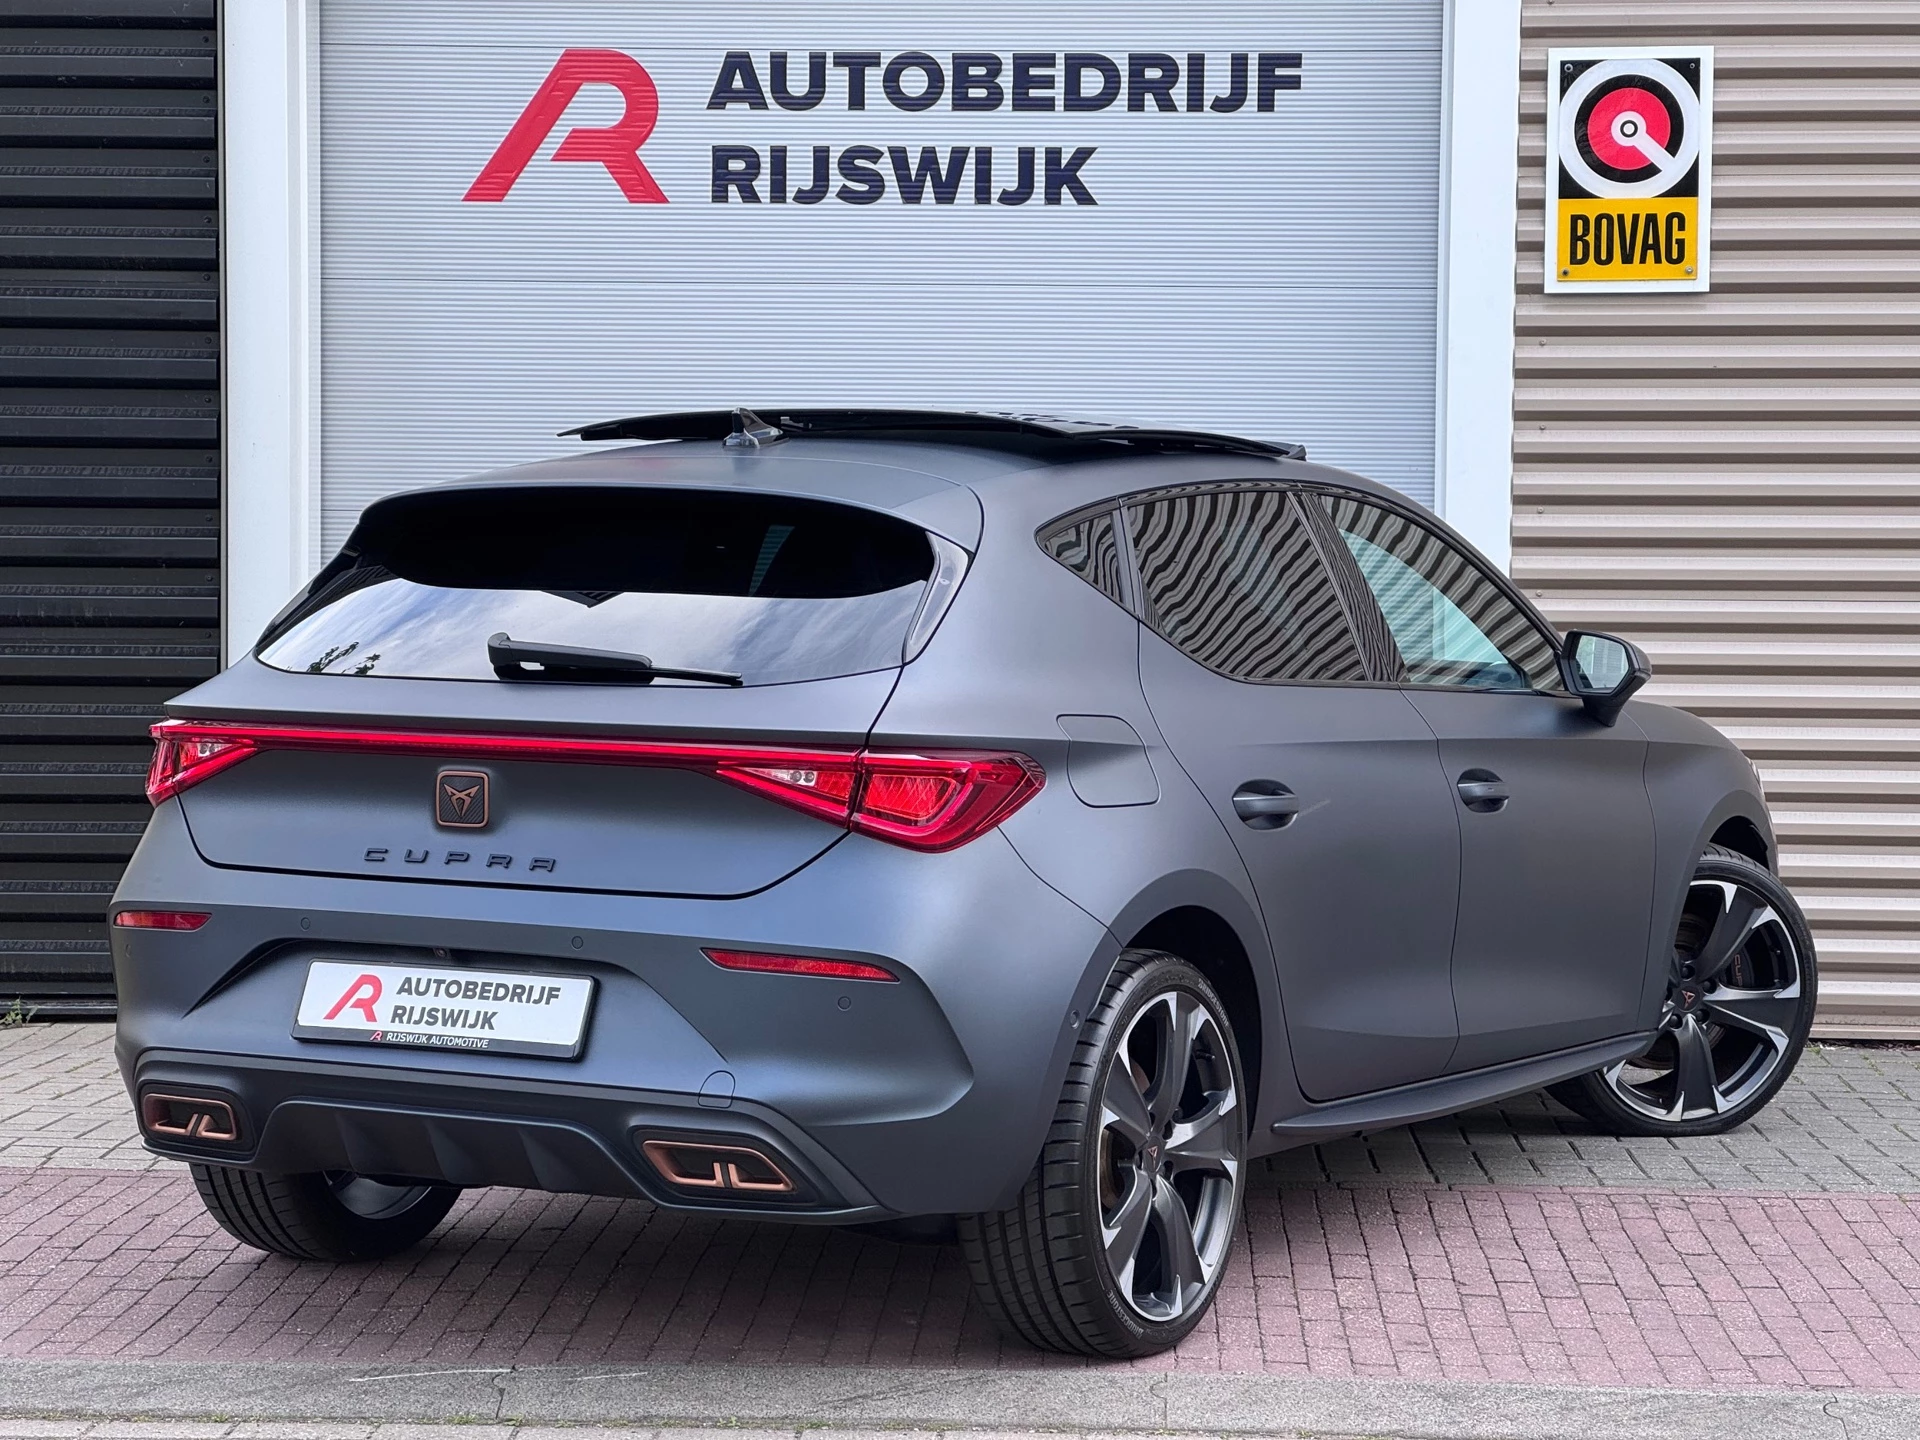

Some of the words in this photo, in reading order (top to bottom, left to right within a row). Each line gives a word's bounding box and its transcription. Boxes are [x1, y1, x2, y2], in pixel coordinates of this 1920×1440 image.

[706, 51, 1303, 113] AUTOBEDRIJF
[711, 145, 1098, 206] RIJSWIJK
[1569, 212, 1686, 266] BOVAG
[363, 848, 556, 872] CUPRA
[396, 976, 561, 1006] AUTOBEDRIJF
[389, 1004, 499, 1031] RIJSWIJK
[386, 1032, 429, 1044] RIJSWIJK
[429, 1037, 489, 1048] AUTOMOTIVE
[1106, 1289, 1145, 1340] BRIDGESTONE
